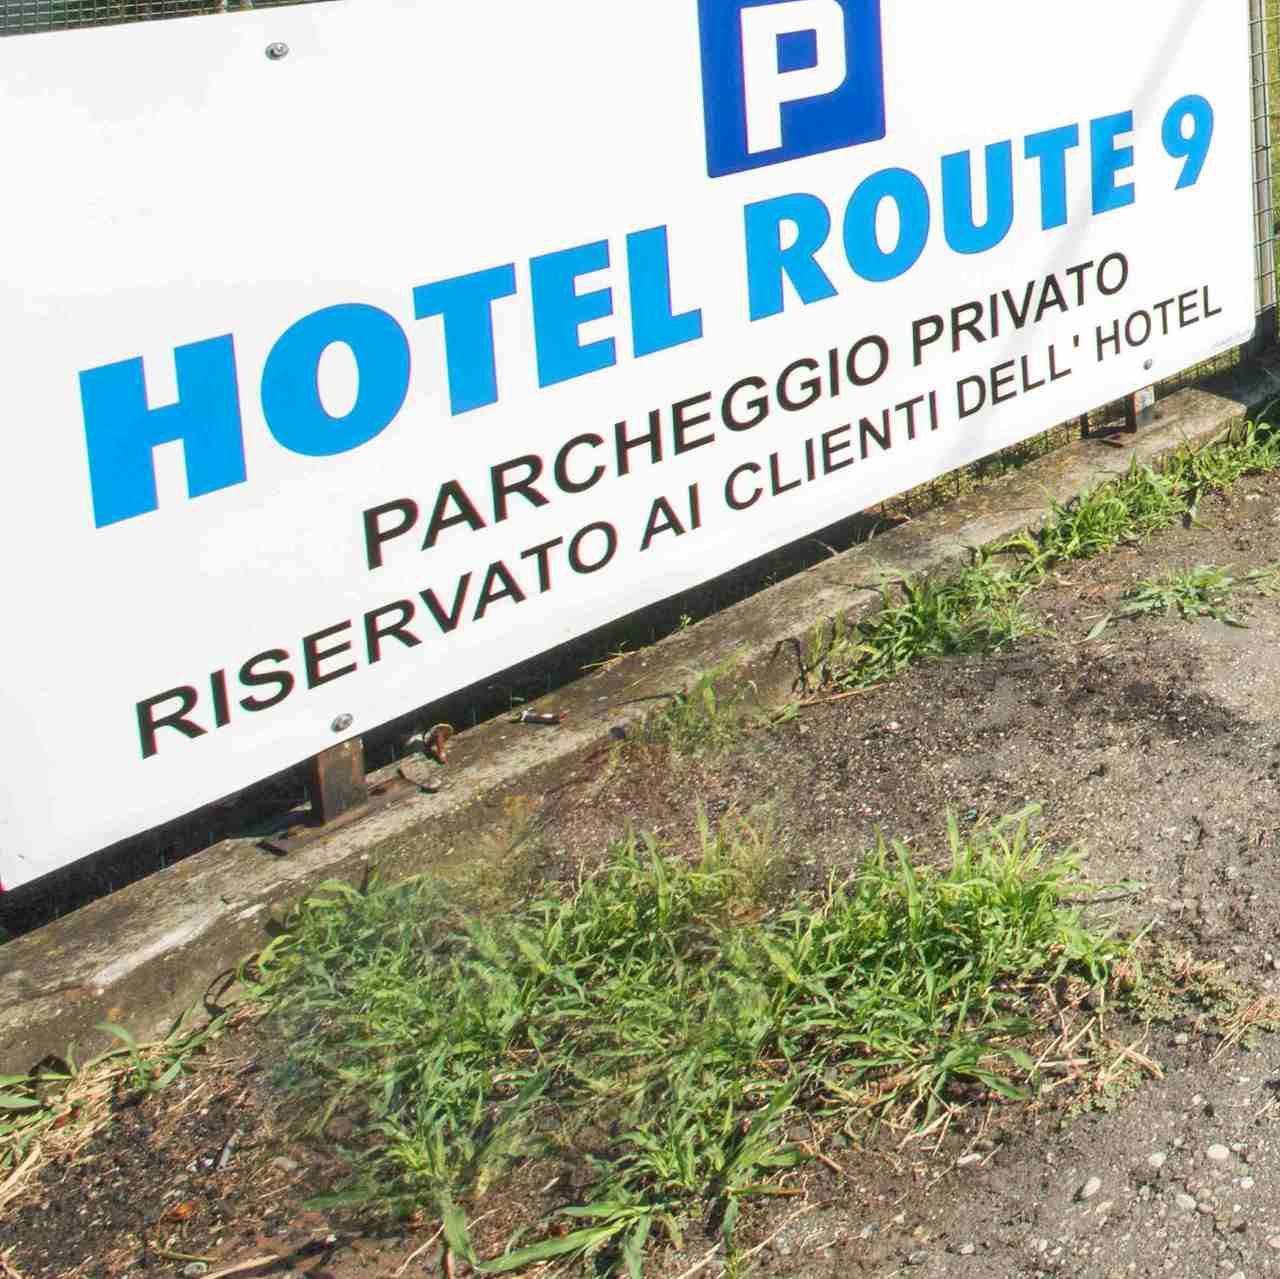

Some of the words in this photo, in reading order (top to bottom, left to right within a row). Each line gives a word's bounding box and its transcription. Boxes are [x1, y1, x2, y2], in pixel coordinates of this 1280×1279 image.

[79, 224, 702, 529] HOTEL
[743, 111, 1136, 321] ROUTE
[1161, 93, 1214, 189] 9
[136, 521, 617, 759] RISERVATO
[640, 483, 701, 551] AI
[721, 390, 938, 512] CLIENTI
[956, 334, 1081, 419] DELL'
[1096, 282, 1222, 362] HOTEL
[363, 335, 889, 570] PARCHEGGIO
[912, 252, 1128, 367] PRIVATO
